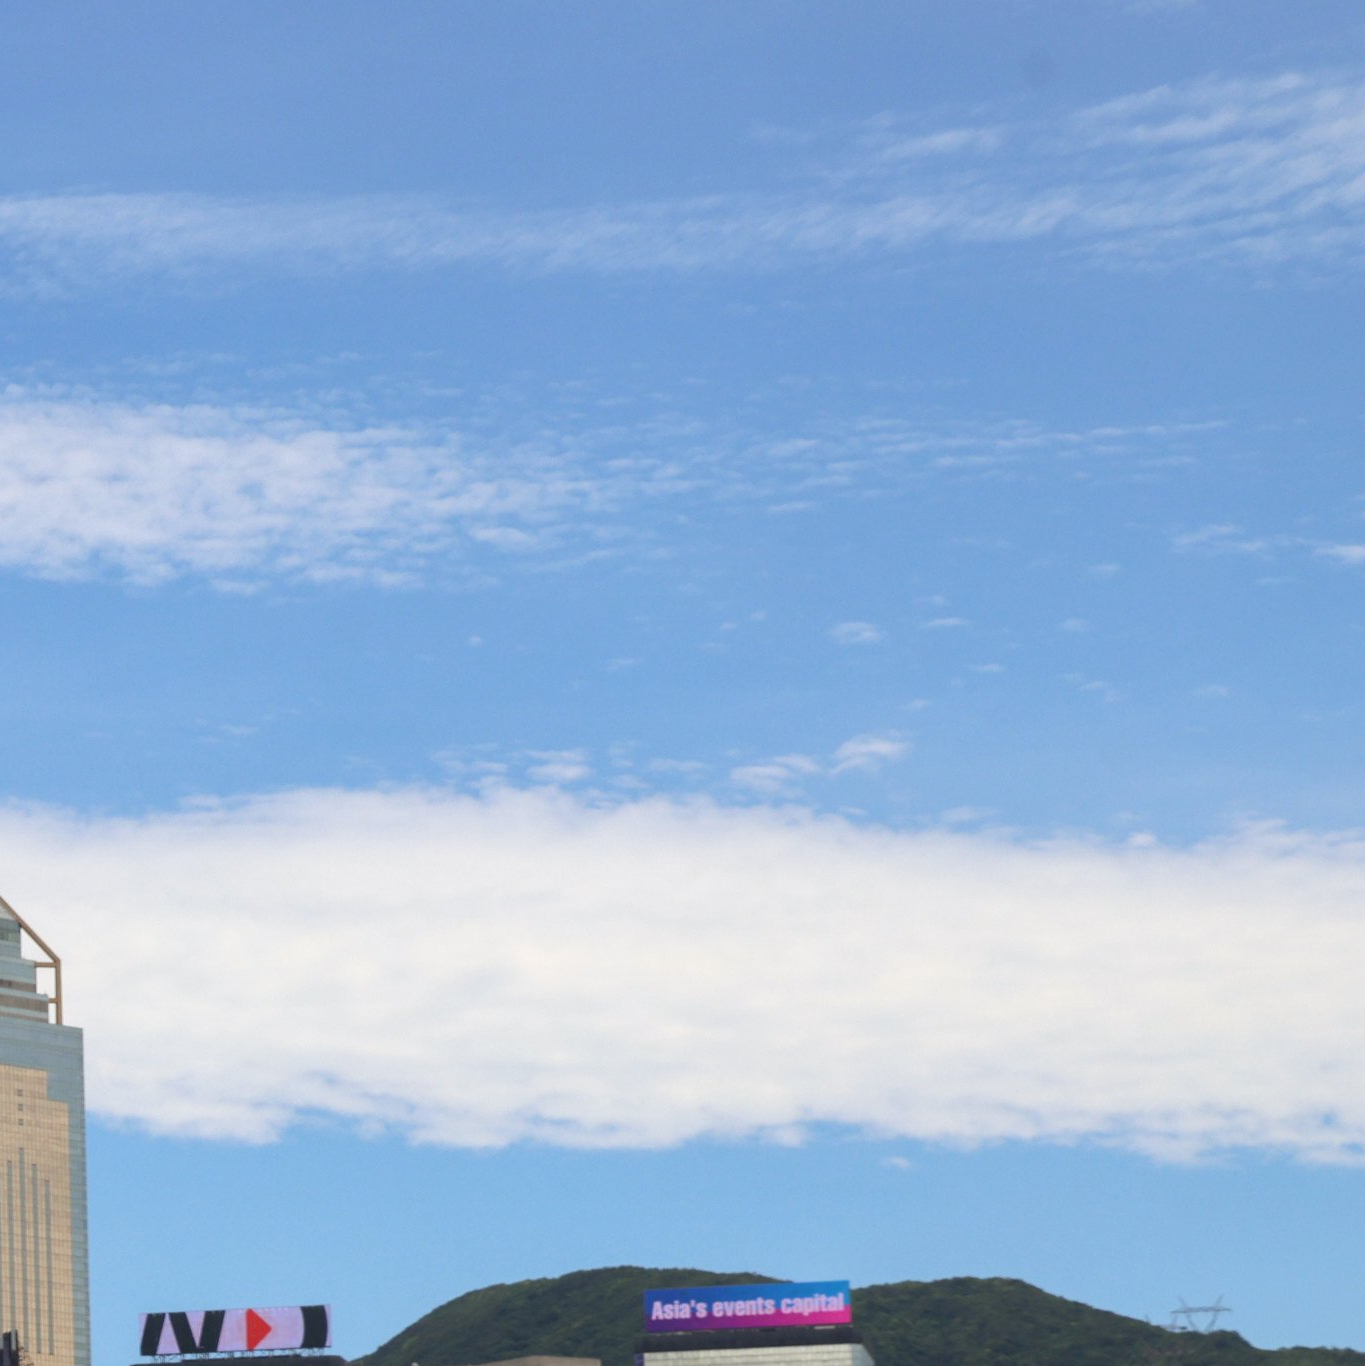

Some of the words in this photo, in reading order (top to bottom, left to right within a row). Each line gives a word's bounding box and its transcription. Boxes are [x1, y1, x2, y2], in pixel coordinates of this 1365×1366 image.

[651, 1299, 707, 1320] Asia's
[712, 1296, 775, 1317] events
[780, 1292, 845, 1316] capital
